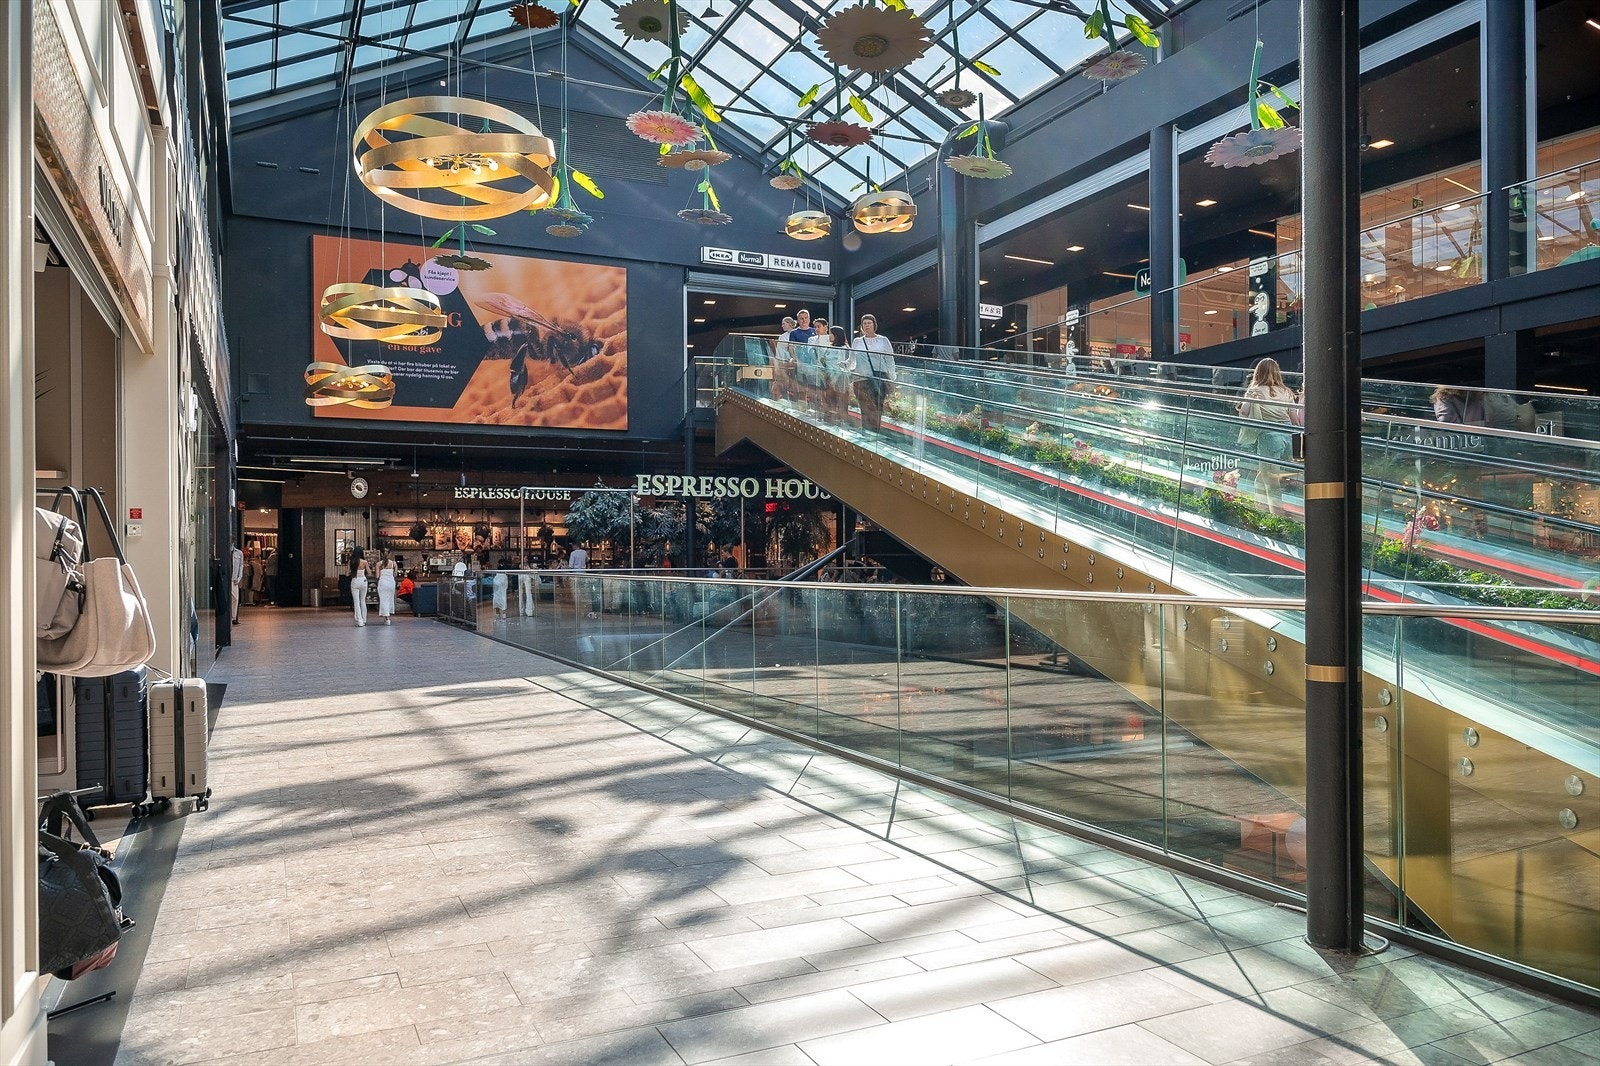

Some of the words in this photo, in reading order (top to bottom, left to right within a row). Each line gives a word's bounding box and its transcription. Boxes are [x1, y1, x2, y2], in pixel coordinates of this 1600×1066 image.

[740, 254, 762, 264] Normal
[774, 258, 801, 269] REMA
[802, 261, 822, 271] 1000
[420, 346, 442, 354] gave
[635, 474, 760, 499] ESPRESSO
[454, 487, 521, 500] ESPRESSO
[524, 489, 572, 500] HOUSE
